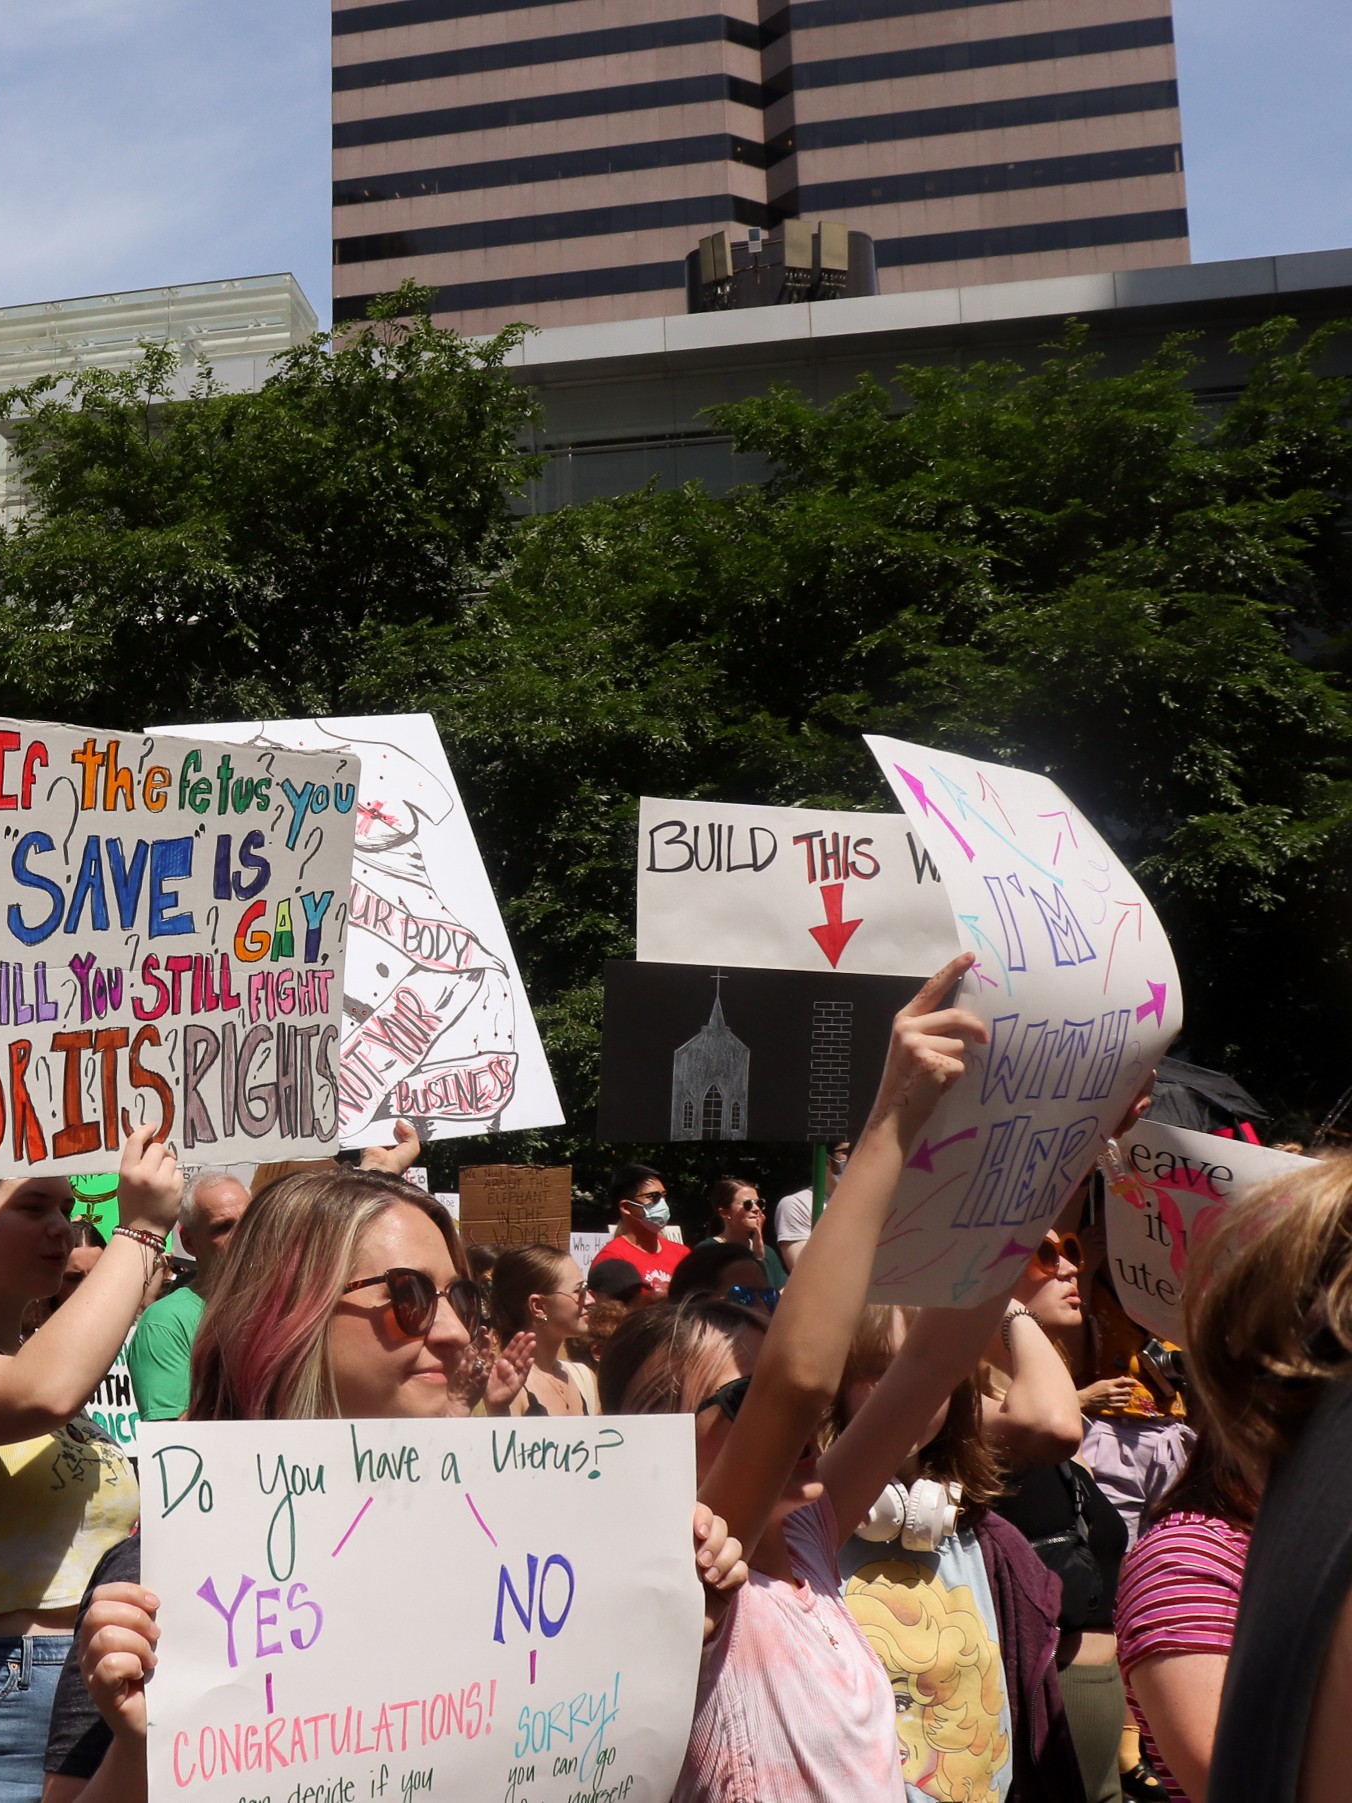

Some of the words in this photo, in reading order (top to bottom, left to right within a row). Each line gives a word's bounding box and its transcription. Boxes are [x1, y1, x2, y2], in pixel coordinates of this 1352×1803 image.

[72, 737, 173, 812] the
[178, 748, 272, 815] fetus
[282, 779, 355, 851] you
[213, 829, 271, 901] IS
[646, 820, 778, 873] BUILD
[793, 830, 881, 885] THIS
[402, 914, 471, 969] BODY
[983, 872, 1096, 972] I'M
[131, 952, 242, 1021] STILL
[248, 969, 335, 1023] FIGHT
[361, 987, 444, 1065] YOUR
[981, 1008, 1132, 1105] WITH
[50, 1024, 176, 1162] ITS
[183, 1022, 340, 1149] RIGHTS
[398, 1056, 513, 1115] BUSINESS
[487, 1190, 551, 1205] ELEPHANT
[529, 1176, 551, 1189] THE
[950, 1115, 1100, 1229] HER
[1129, 1143, 1234, 1198] eave
[492, 1223, 549, 1247] WOMB
[515, 1206, 545, 1223] THE
[1144, 1200, 1171, 1248] it
[151, 1444, 214, 1519] Do
[349, 1423, 421, 1485] have
[440, 1449, 462, 1485] a
[196, 1572, 326, 1668] YES
[491, 1552, 576, 1645] NO
[172, 1677, 498, 1788] CONGRATULATIONS!
[286, 1775, 356, 1803] decide
[370, 1763, 390, 1800] if
[401, 1766, 434, 1800] you
[504, 1764, 536, 1803] you
[552, 1756, 579, 1778] can
[592, 1746, 617, 1794] go
